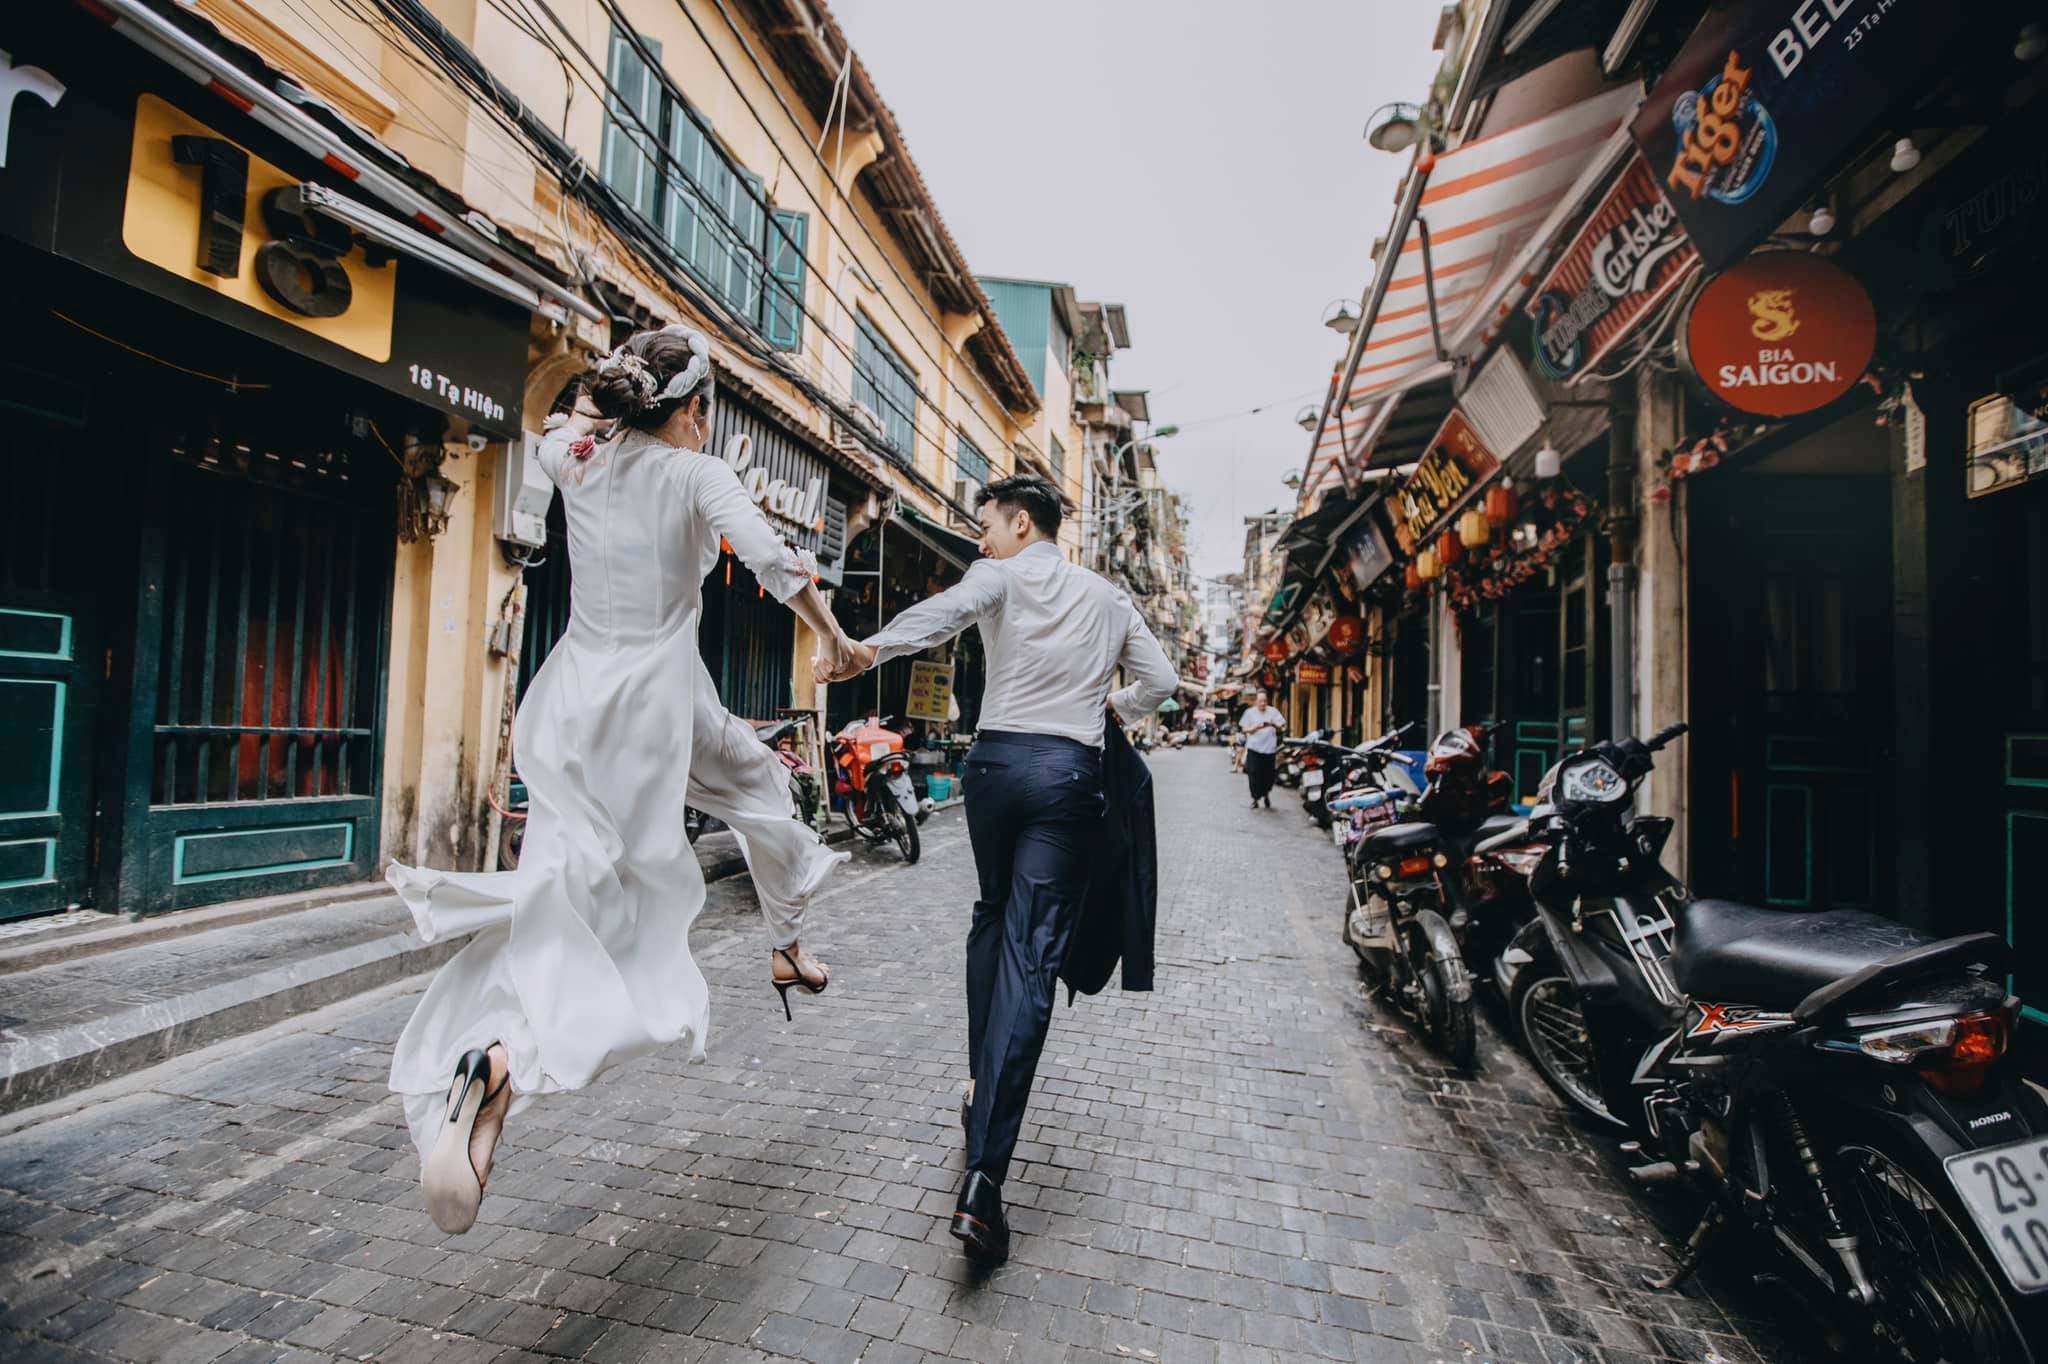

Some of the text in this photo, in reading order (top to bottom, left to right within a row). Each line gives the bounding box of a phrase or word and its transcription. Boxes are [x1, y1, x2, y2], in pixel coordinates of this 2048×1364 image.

[1843, 26, 1863, 50] 23
[1860, 14, 1880, 30] Tạ
[1667, 49, 1752, 201] Tiger
[171, 134, 353, 318] 18
[1758, 348, 1794, 363] BIA
[409, 364, 432, 390] 18
[437, 374, 460, 405] Tạ
[1719, 361, 1836, 388] SAIGON
[1969, 1111, 2011, 1129] HONDA
